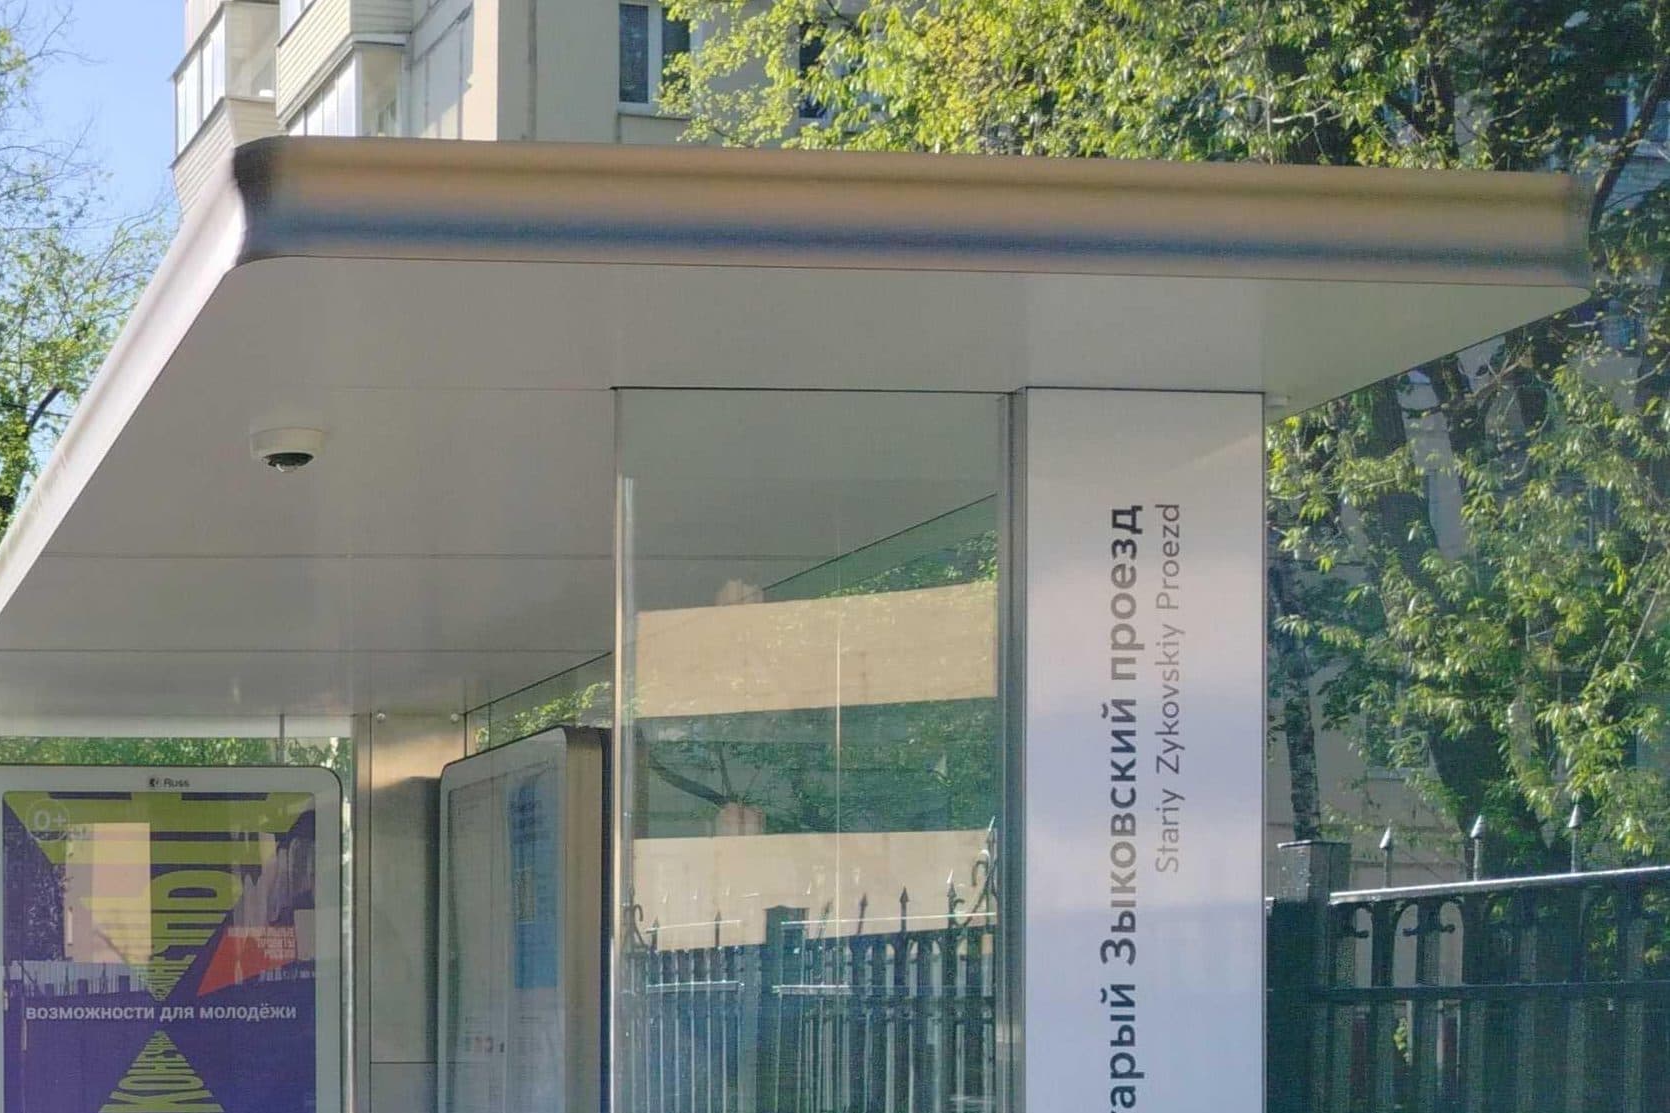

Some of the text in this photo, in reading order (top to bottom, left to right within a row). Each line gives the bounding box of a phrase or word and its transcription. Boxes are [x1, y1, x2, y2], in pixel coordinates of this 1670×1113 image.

[1109, 503, 1144, 681] проезд
[1154, 503, 1185, 873] Stariy Zykovskiy Proezd
[33, 809, 67, 832] 0+
[163, 778, 190, 788] Russ
[1099, 699, 1137, 967] Зыковский
[25, 1002, 297, 1022] возможности для молодёжи
